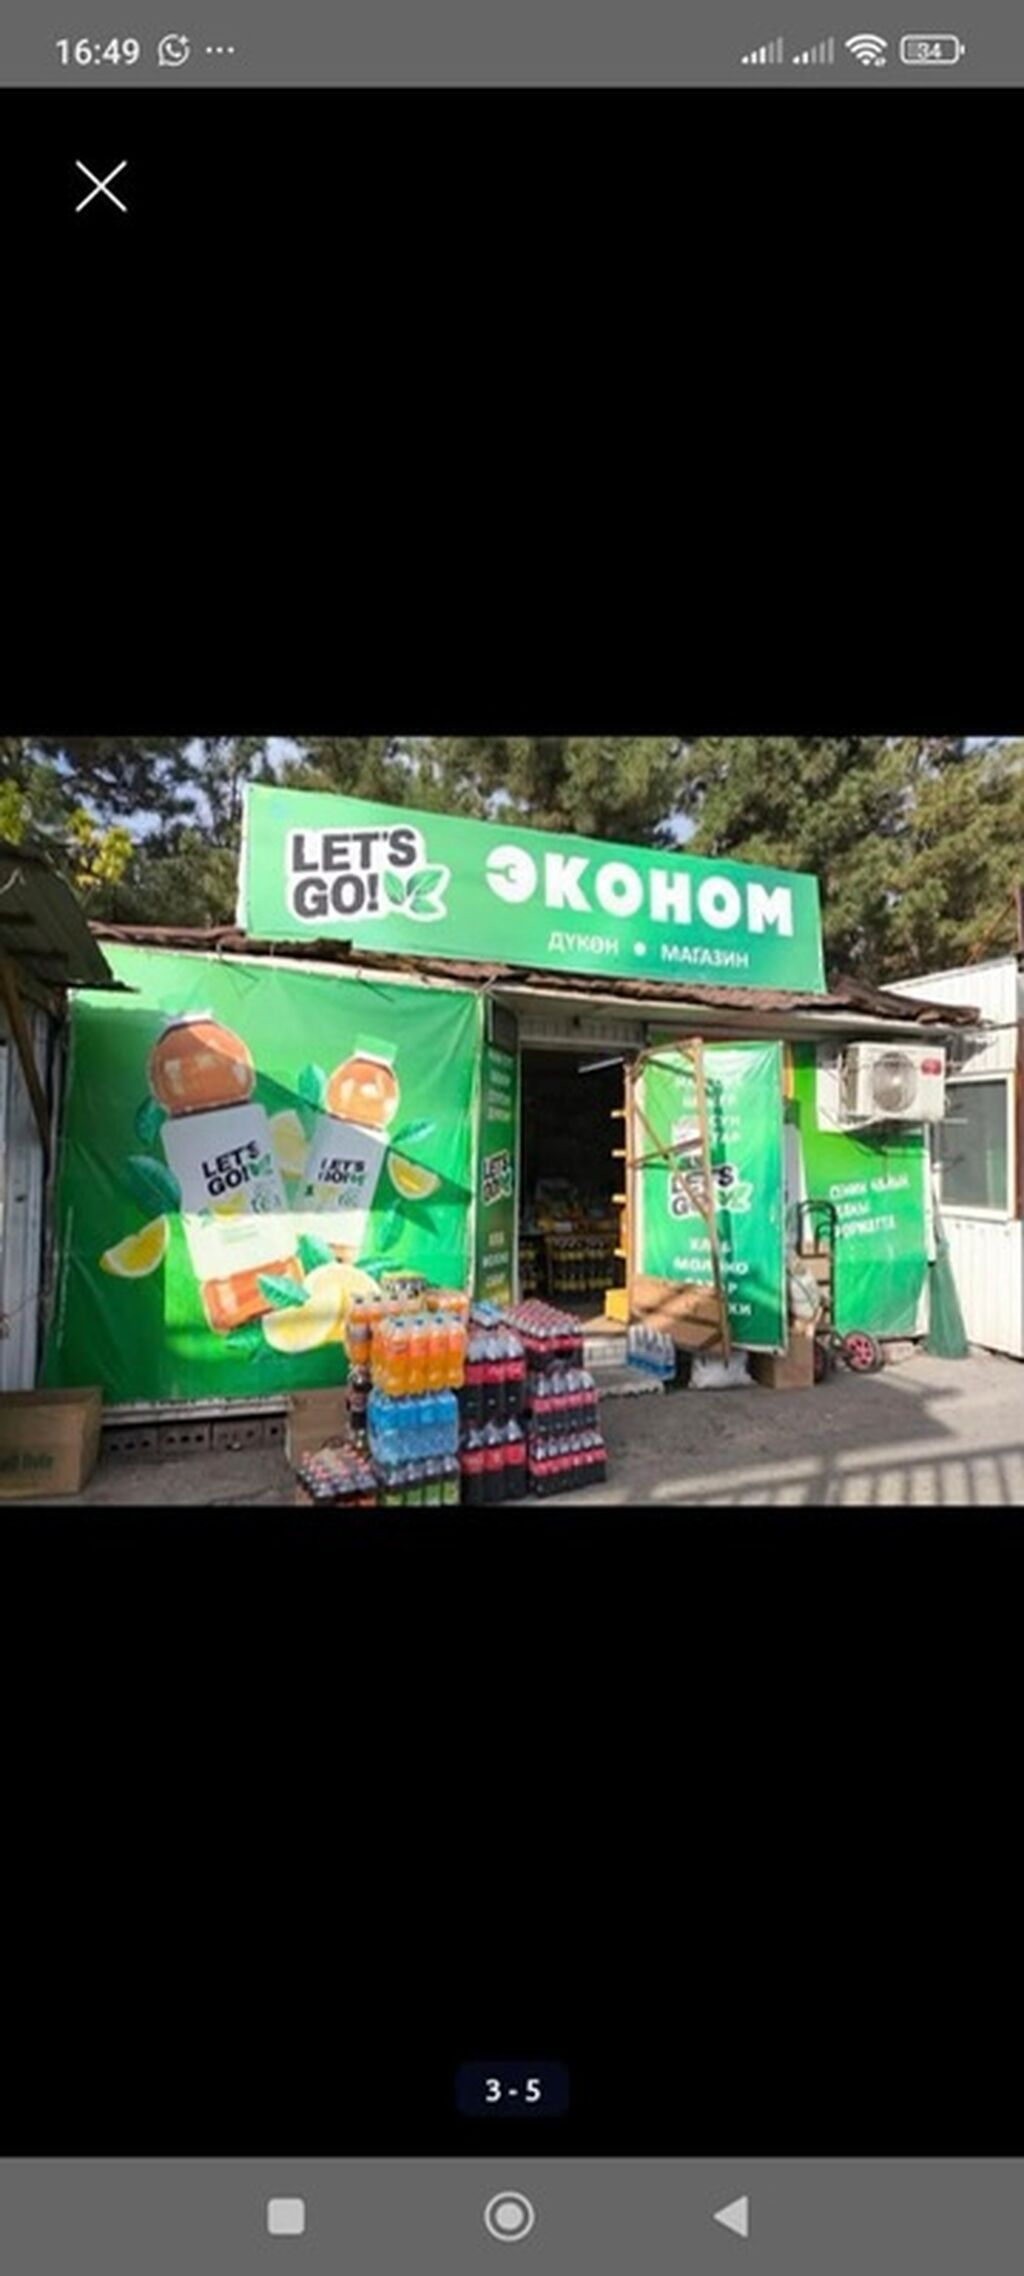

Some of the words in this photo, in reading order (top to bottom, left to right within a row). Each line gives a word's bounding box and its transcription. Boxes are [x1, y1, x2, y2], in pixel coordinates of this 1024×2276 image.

[291, 828, 418, 872] LET'S
[292, 875, 380, 919] GO!
[485, 844, 795, 937] ЭКОНОМ
[547, 930, 619, 957] ДҮКӨН
[660, 943, 750, 970] МАГАЗИН
